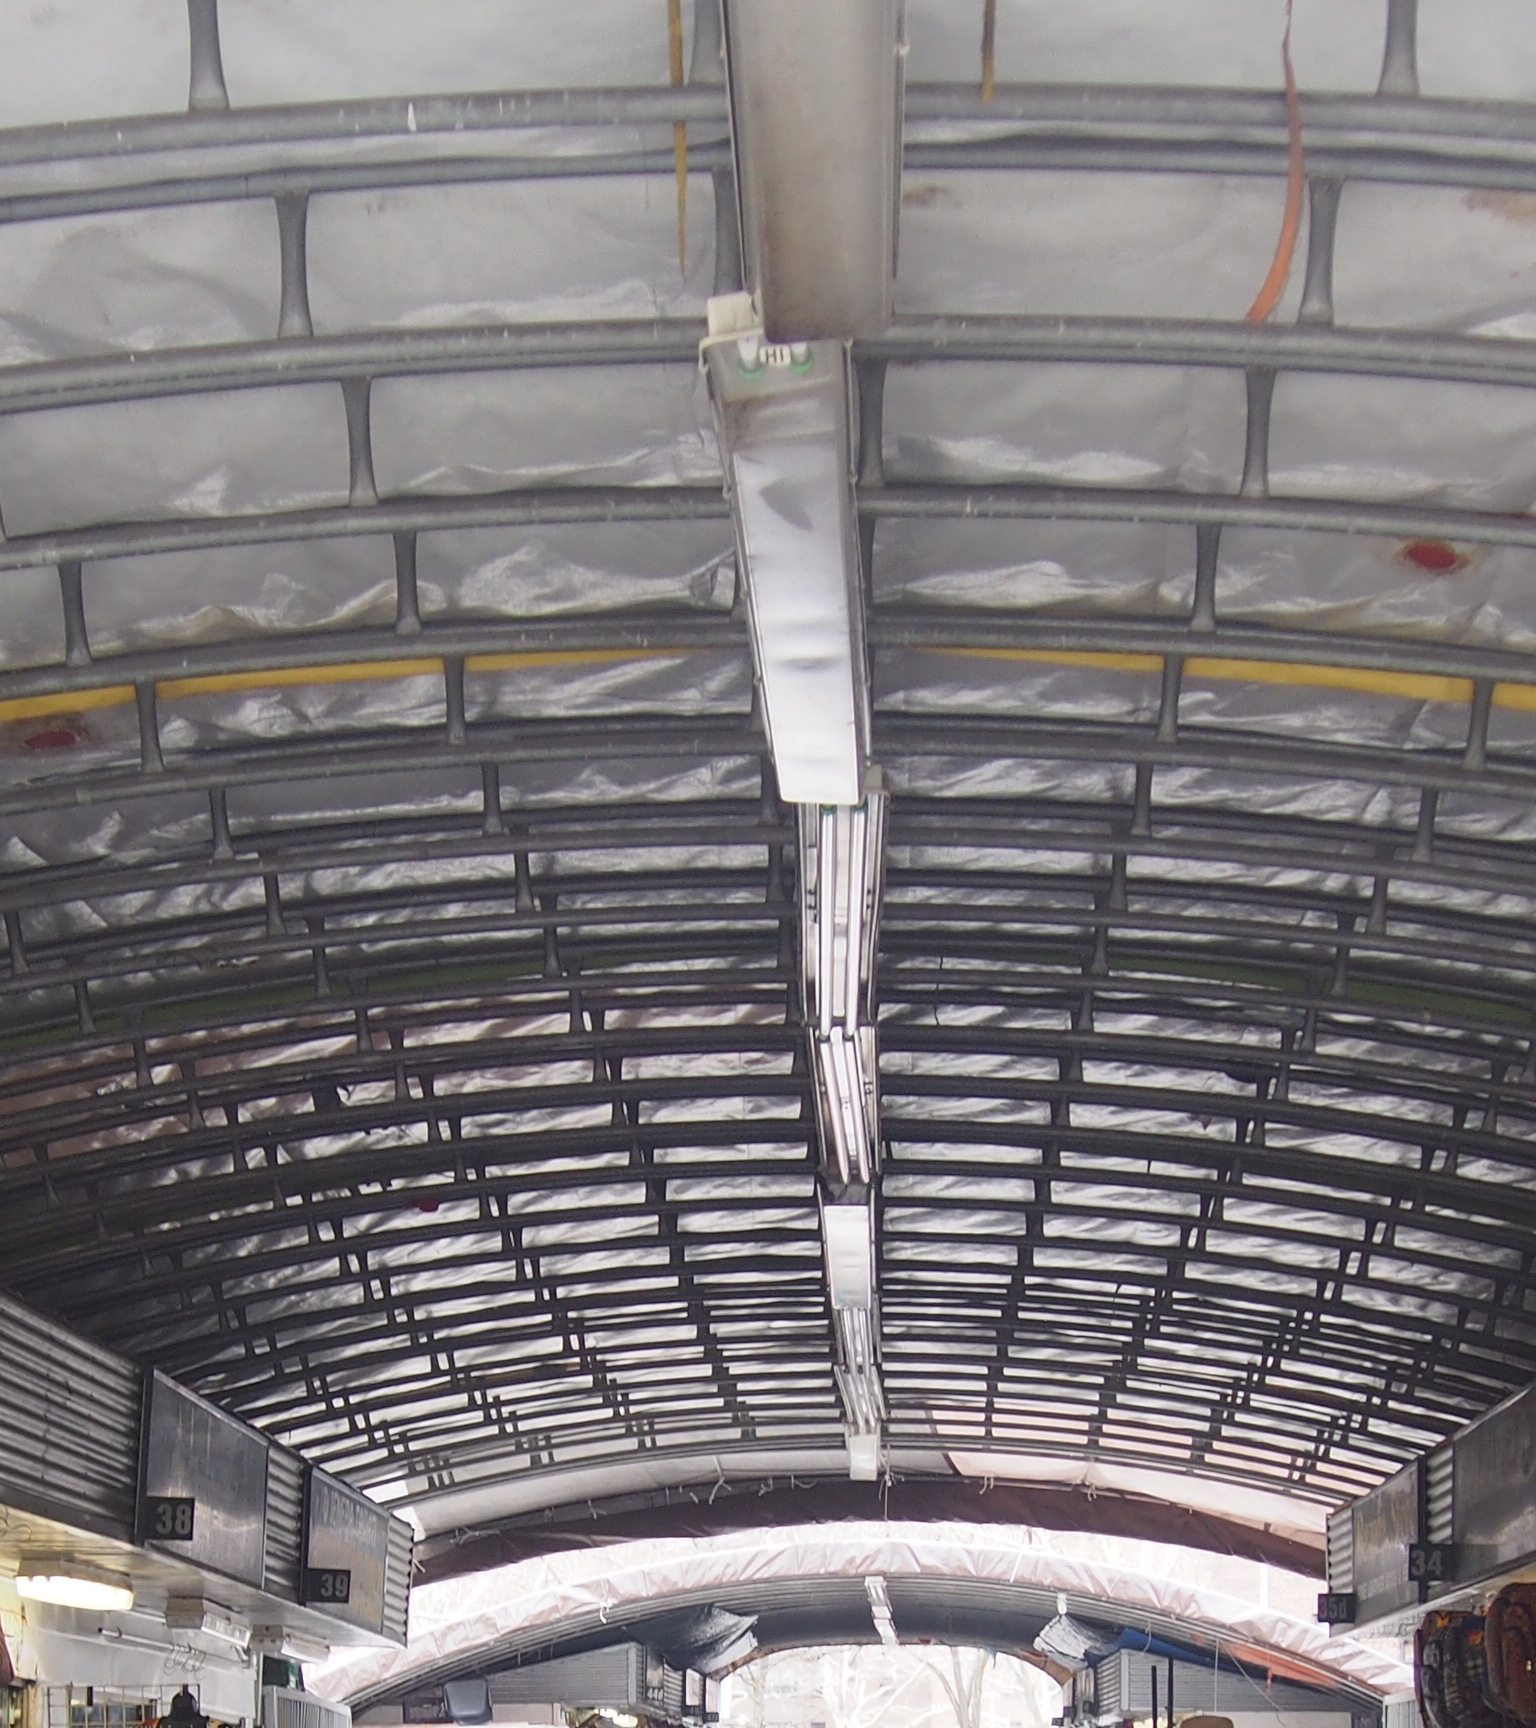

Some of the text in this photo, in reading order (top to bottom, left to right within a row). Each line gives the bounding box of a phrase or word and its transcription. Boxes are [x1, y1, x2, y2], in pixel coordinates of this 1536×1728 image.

[156, 1503, 192, 1536] 38
[1411, 1550, 1442, 1576] 34
[320, 1573, 350, 1598] 39
